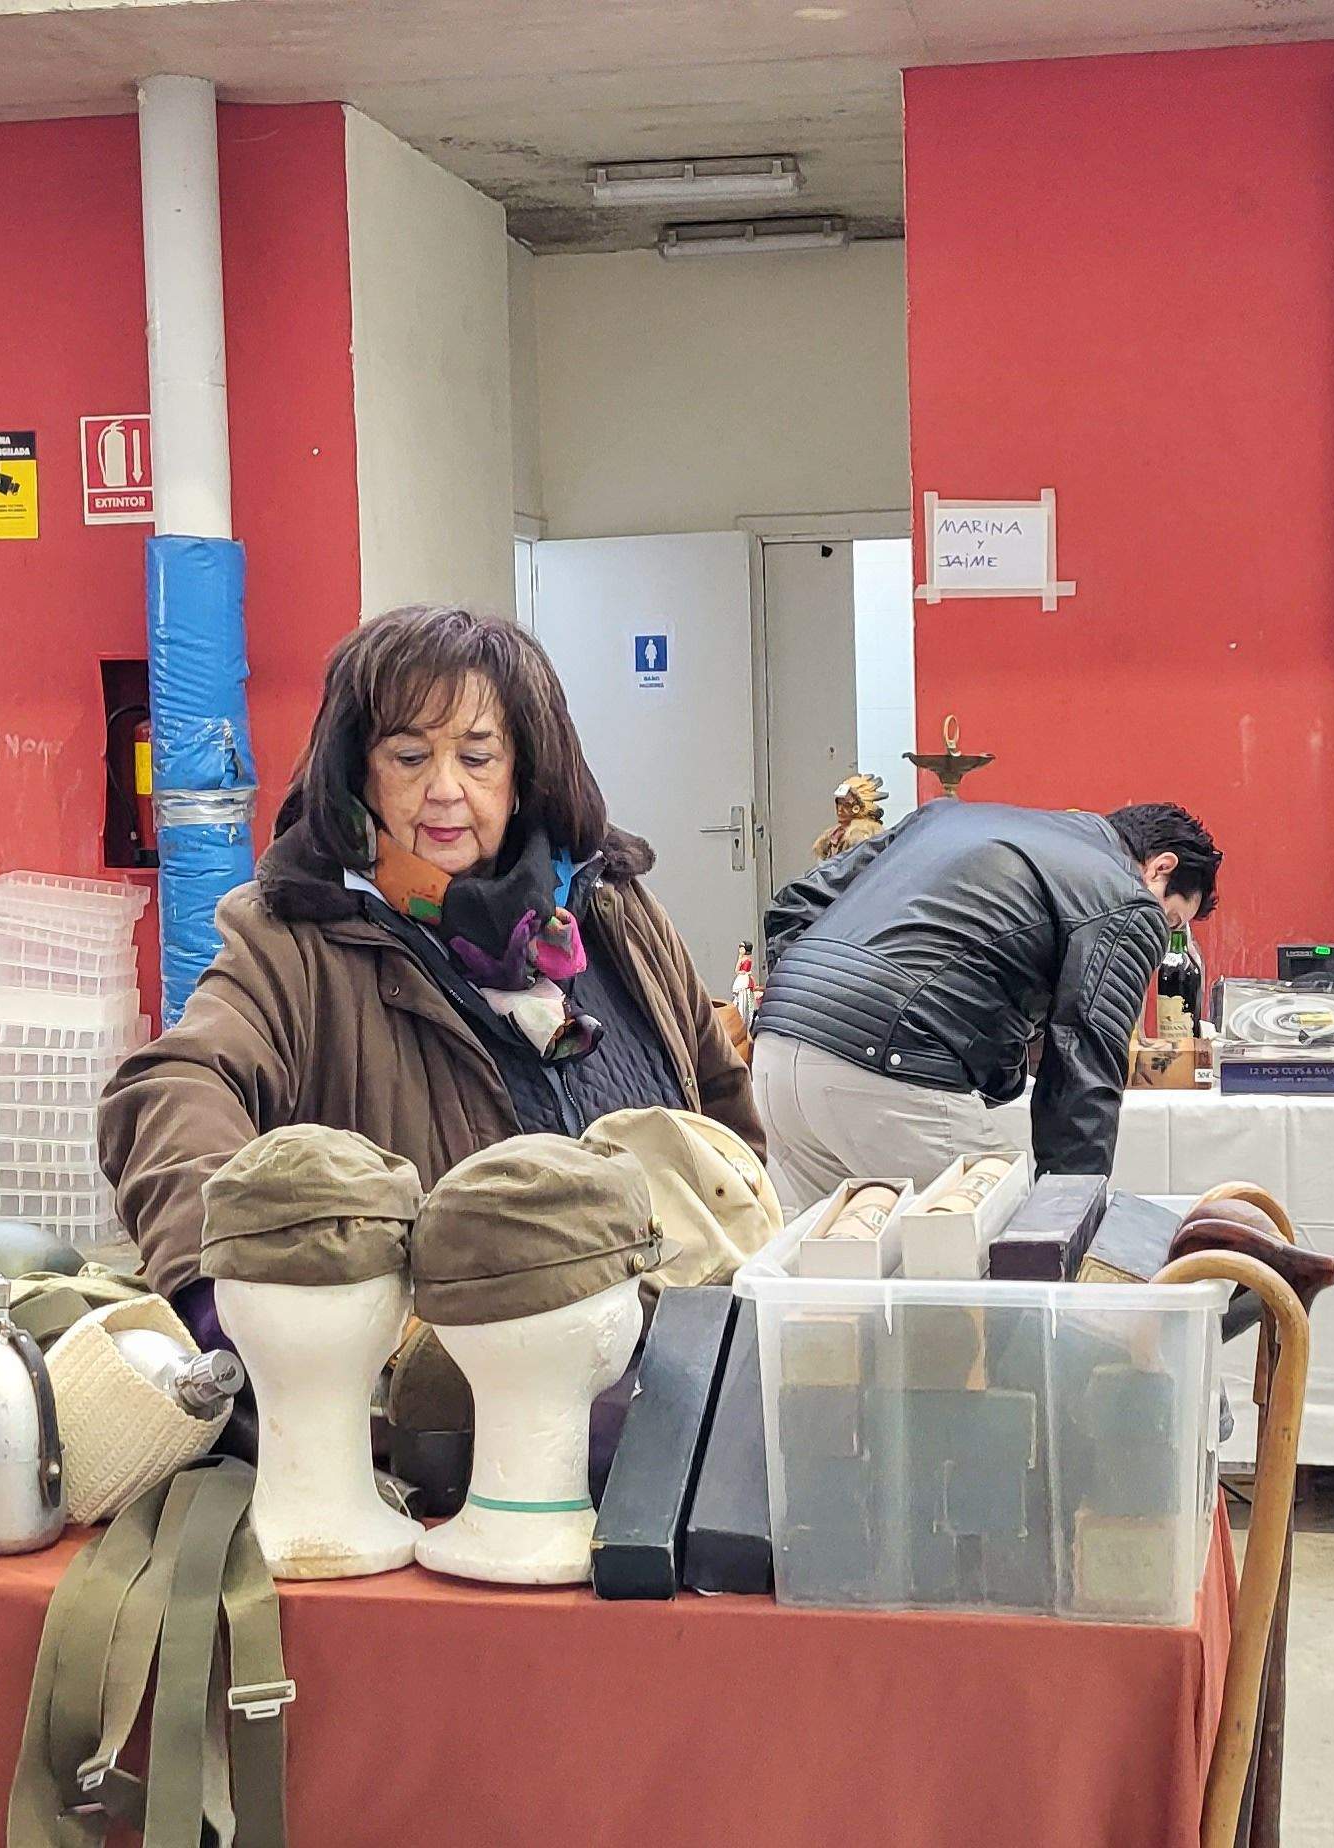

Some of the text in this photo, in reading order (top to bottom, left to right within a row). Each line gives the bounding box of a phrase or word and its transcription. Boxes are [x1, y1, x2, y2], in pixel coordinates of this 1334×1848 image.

[95, 496, 146, 508] EXTINTOR
[938, 519, 1023, 535] MARINA
[1282, 1067, 1305, 1075] CUPS
